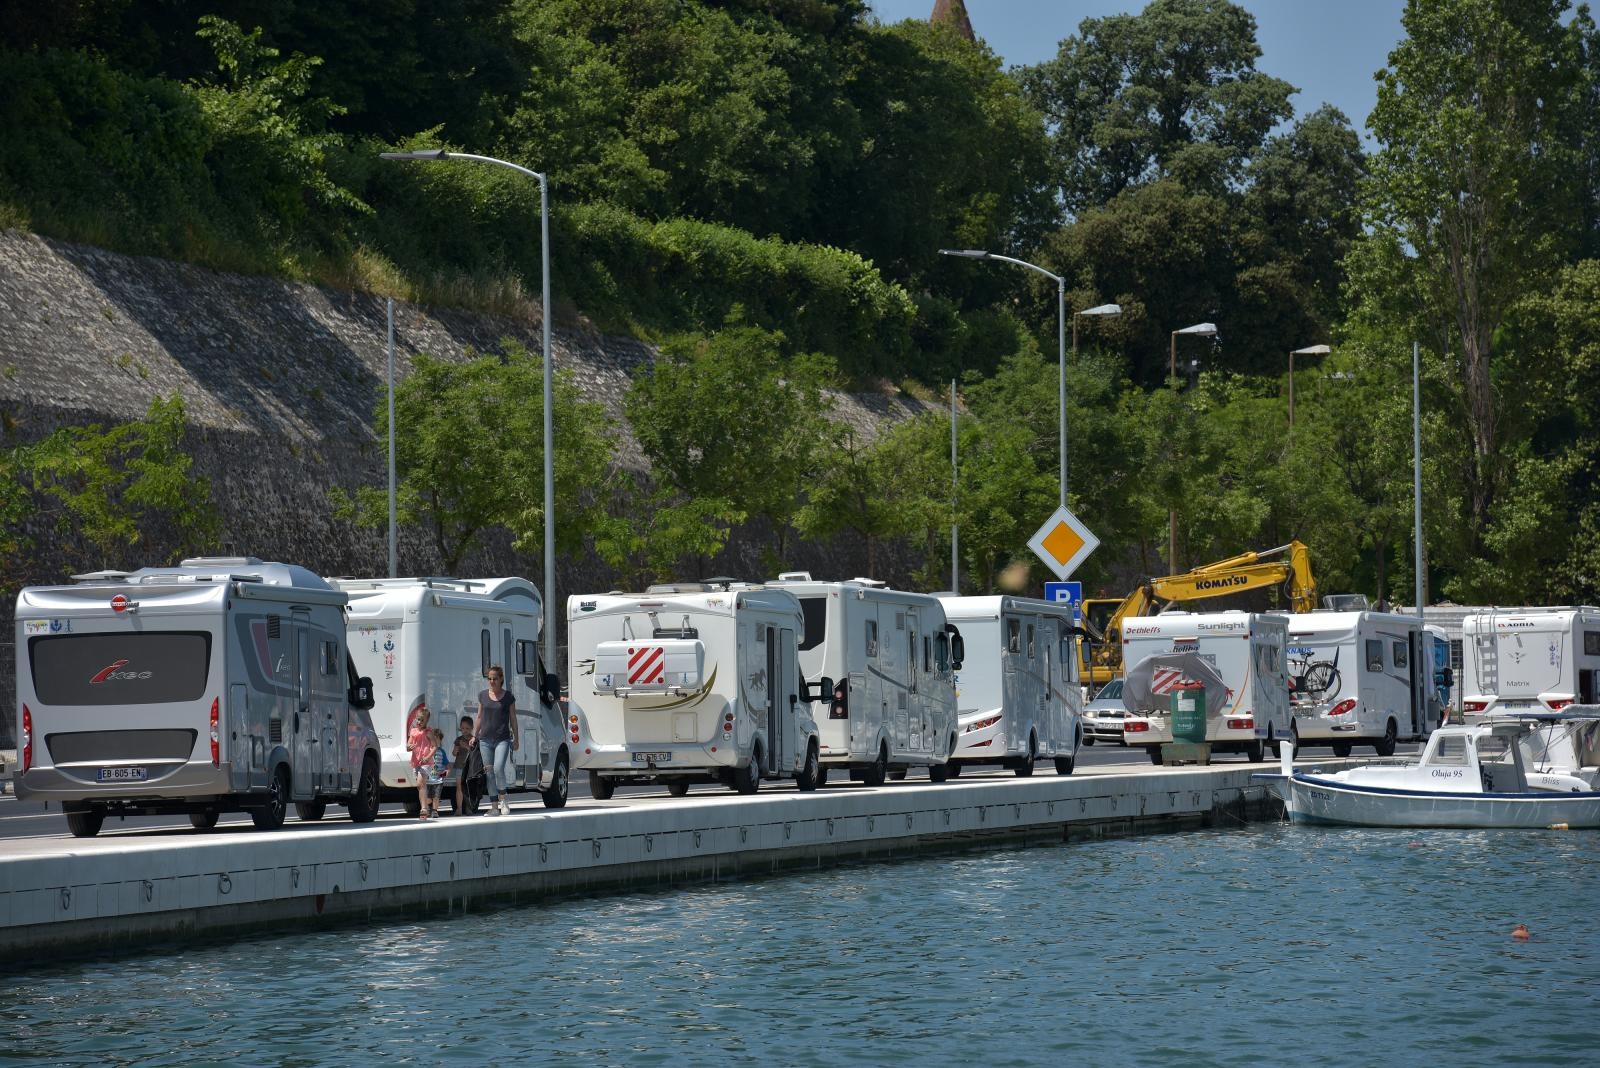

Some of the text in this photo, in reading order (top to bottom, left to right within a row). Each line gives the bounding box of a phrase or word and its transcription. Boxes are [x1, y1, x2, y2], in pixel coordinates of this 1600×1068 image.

[1195, 575, 1248, 590] KOMATSU
[1055, 590, 1071, 602] P
[1126, 626, 1161, 634] Dethleffs
[1198, 621, 1246, 631] Sunlight
[1506, 680, 1530, 688] Matrix
[1431, 769, 1463, 780] Oluja 95
